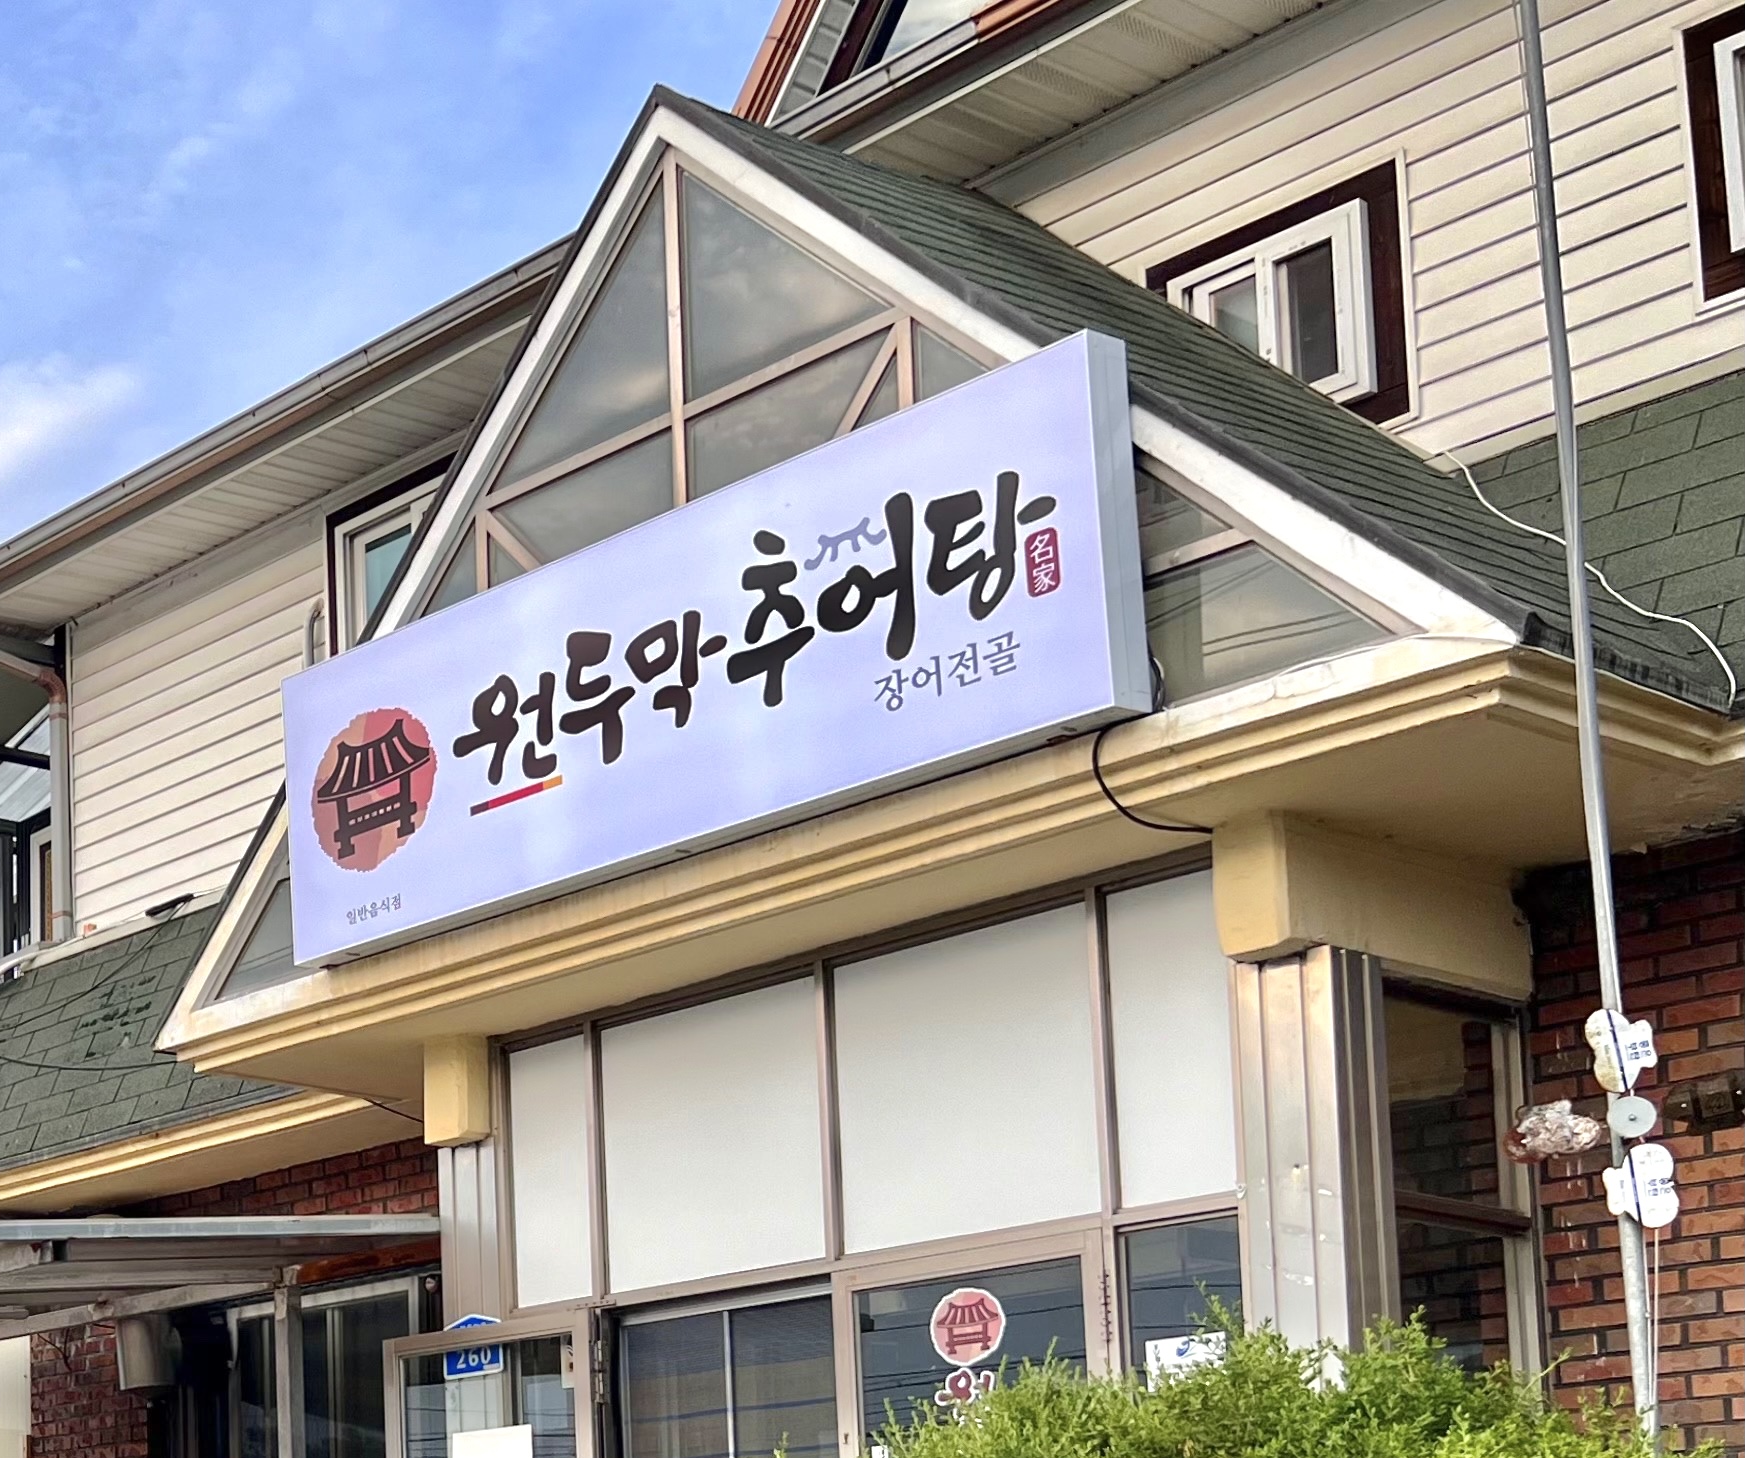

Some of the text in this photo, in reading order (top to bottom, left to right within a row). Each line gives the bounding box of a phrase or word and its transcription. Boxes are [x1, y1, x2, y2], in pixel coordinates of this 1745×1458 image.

[1029, 532, 1057, 594] 名家
[873, 630, 1021, 712] 장어전골
[345, 892, 402, 926] 일반음식점
[456, 1345, 492, 1370] 260
